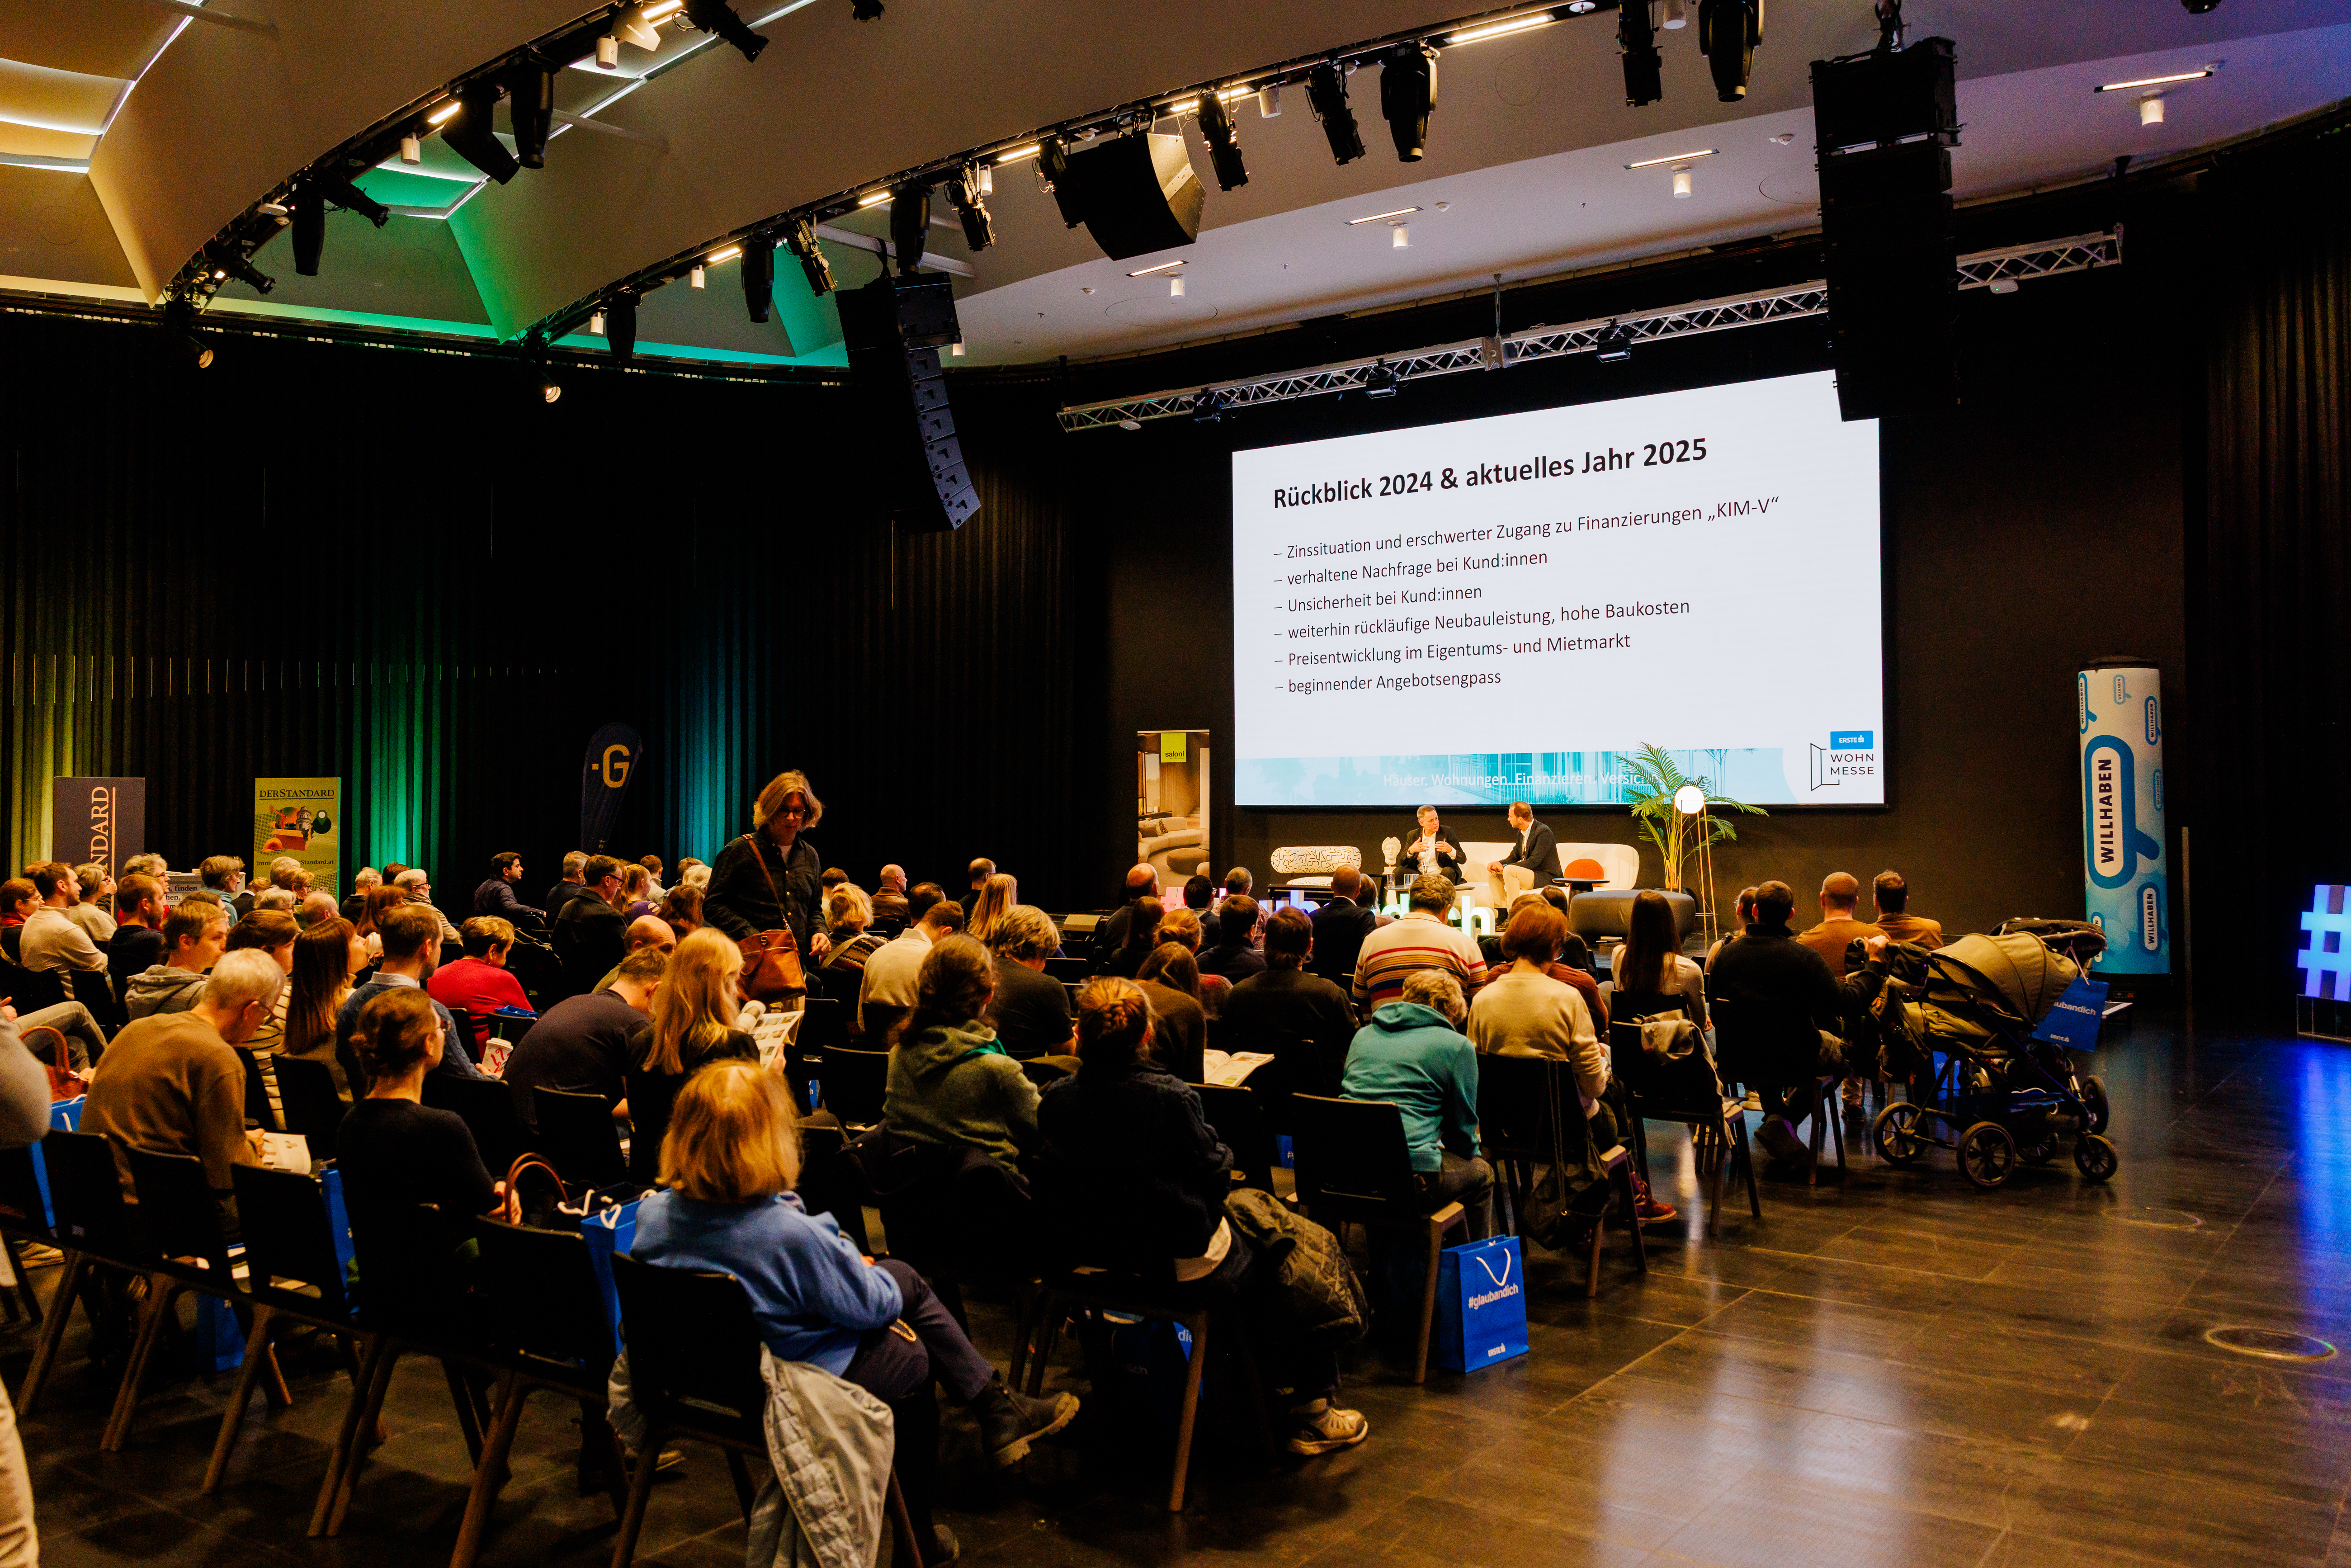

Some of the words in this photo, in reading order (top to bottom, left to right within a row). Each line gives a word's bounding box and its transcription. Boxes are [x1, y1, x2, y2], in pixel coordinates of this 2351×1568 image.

[1274, 477, 1373, 509] Rückblick
[1379, 471, 1433, 496] 2024
[1440, 468, 1458, 490] &
[1466, 455, 1574, 486] aktuelles
[1581, 447, 1635, 473] Jahr
[1643, 438, 1707, 467] 2025
[1287, 539, 1370, 558] Zinssituation
[1376, 534, 1401, 550] und
[1407, 529, 1492, 547] erschwerter
[1497, 524, 1551, 540] Zugang
[1556, 521, 1572, 533] zu
[1578, 509, 1701, 531] Finanzierungen
[1287, 568, 1358, 585] verhaltene
[1363, 562, 1432, 579] Nachfrage
[1437, 557, 1458, 572] bei
[1463, 553, 1547, 570] Kund:innen
[1289, 593, 1371, 612] Unsicherheit
[1376, 591, 1396, 605] bei
[1402, 587, 1482, 604] Kund:innen
[1288, 622, 1350, 638] weiterhin
[1355, 617, 1430, 634] rückläufige
[1435, 611, 1555, 629] Neubauleistung,
[1561, 605, 1600, 621] hohe
[1606, 601, 1689, 618] Baukosten
[1289, 647, 1401, 666] Preisentwicklung
[1406, 646, 1422, 659] im
[1428, 644, 1508, 661] Eigentums-
[1514, 638, 1541, 653] und
[1548, 633, 1630, 652] Mietmarkt
[1289, 675, 1372, 695] beginnender
[1376, 673, 1501, 691] Angebotsengpass
[1830, 753, 1874, 762] WOHN
[1831, 766, 1874, 775] MESSE
[1384, 774, 1427, 786] Häuser.
[1431, 773, 1511, 788] Wohnungen.
[1515, 773, 1596, 785] Finanzieren.
[2098, 758, 2114, 865] WILLHABEN
[2146, 892, 2155, 946] WILLHABEN
[1468, 1283, 1519, 1310] #glaubandich
